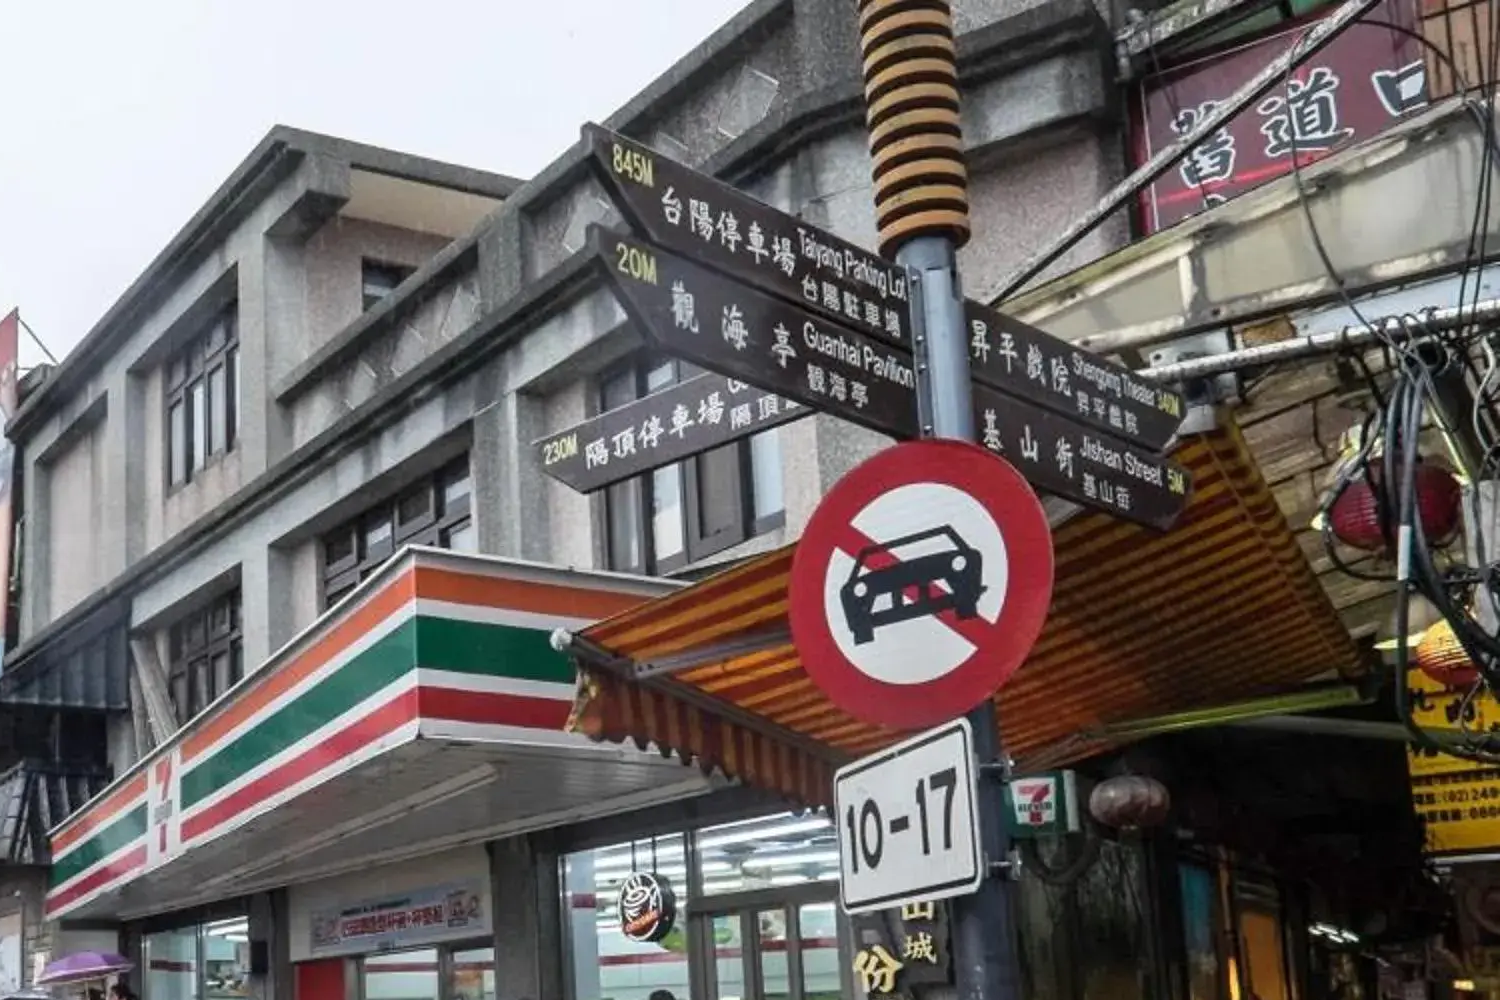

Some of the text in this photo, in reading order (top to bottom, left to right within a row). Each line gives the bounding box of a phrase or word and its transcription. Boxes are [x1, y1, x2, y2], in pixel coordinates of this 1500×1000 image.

[612, 143, 655, 188] 845M
[615, 241, 658, 287] 20M
[661, 186, 797, 278] 台陽停車場
[797, 226, 908, 302] Taiyang Parking Lot
[670, 278, 798, 370] 觀海亭
[803, 320, 916, 389] Guanhai Pavilion
[971, 318, 1073, 398] 昇平戲院
[1072, 351, 1122, 399] Shengping
[1121, 372, 1156, 407] Theater
[543, 432, 579, 467] 230M
[584, 390, 725, 471] 隔頂停車場
[982, 407, 1074, 479] 基山街
[1079, 435, 1123, 471] Jishan
[1123, 451, 1164, 488] Street
[845, 766, 957, 875] 10-17
[852, 943, 904, 995] 份
